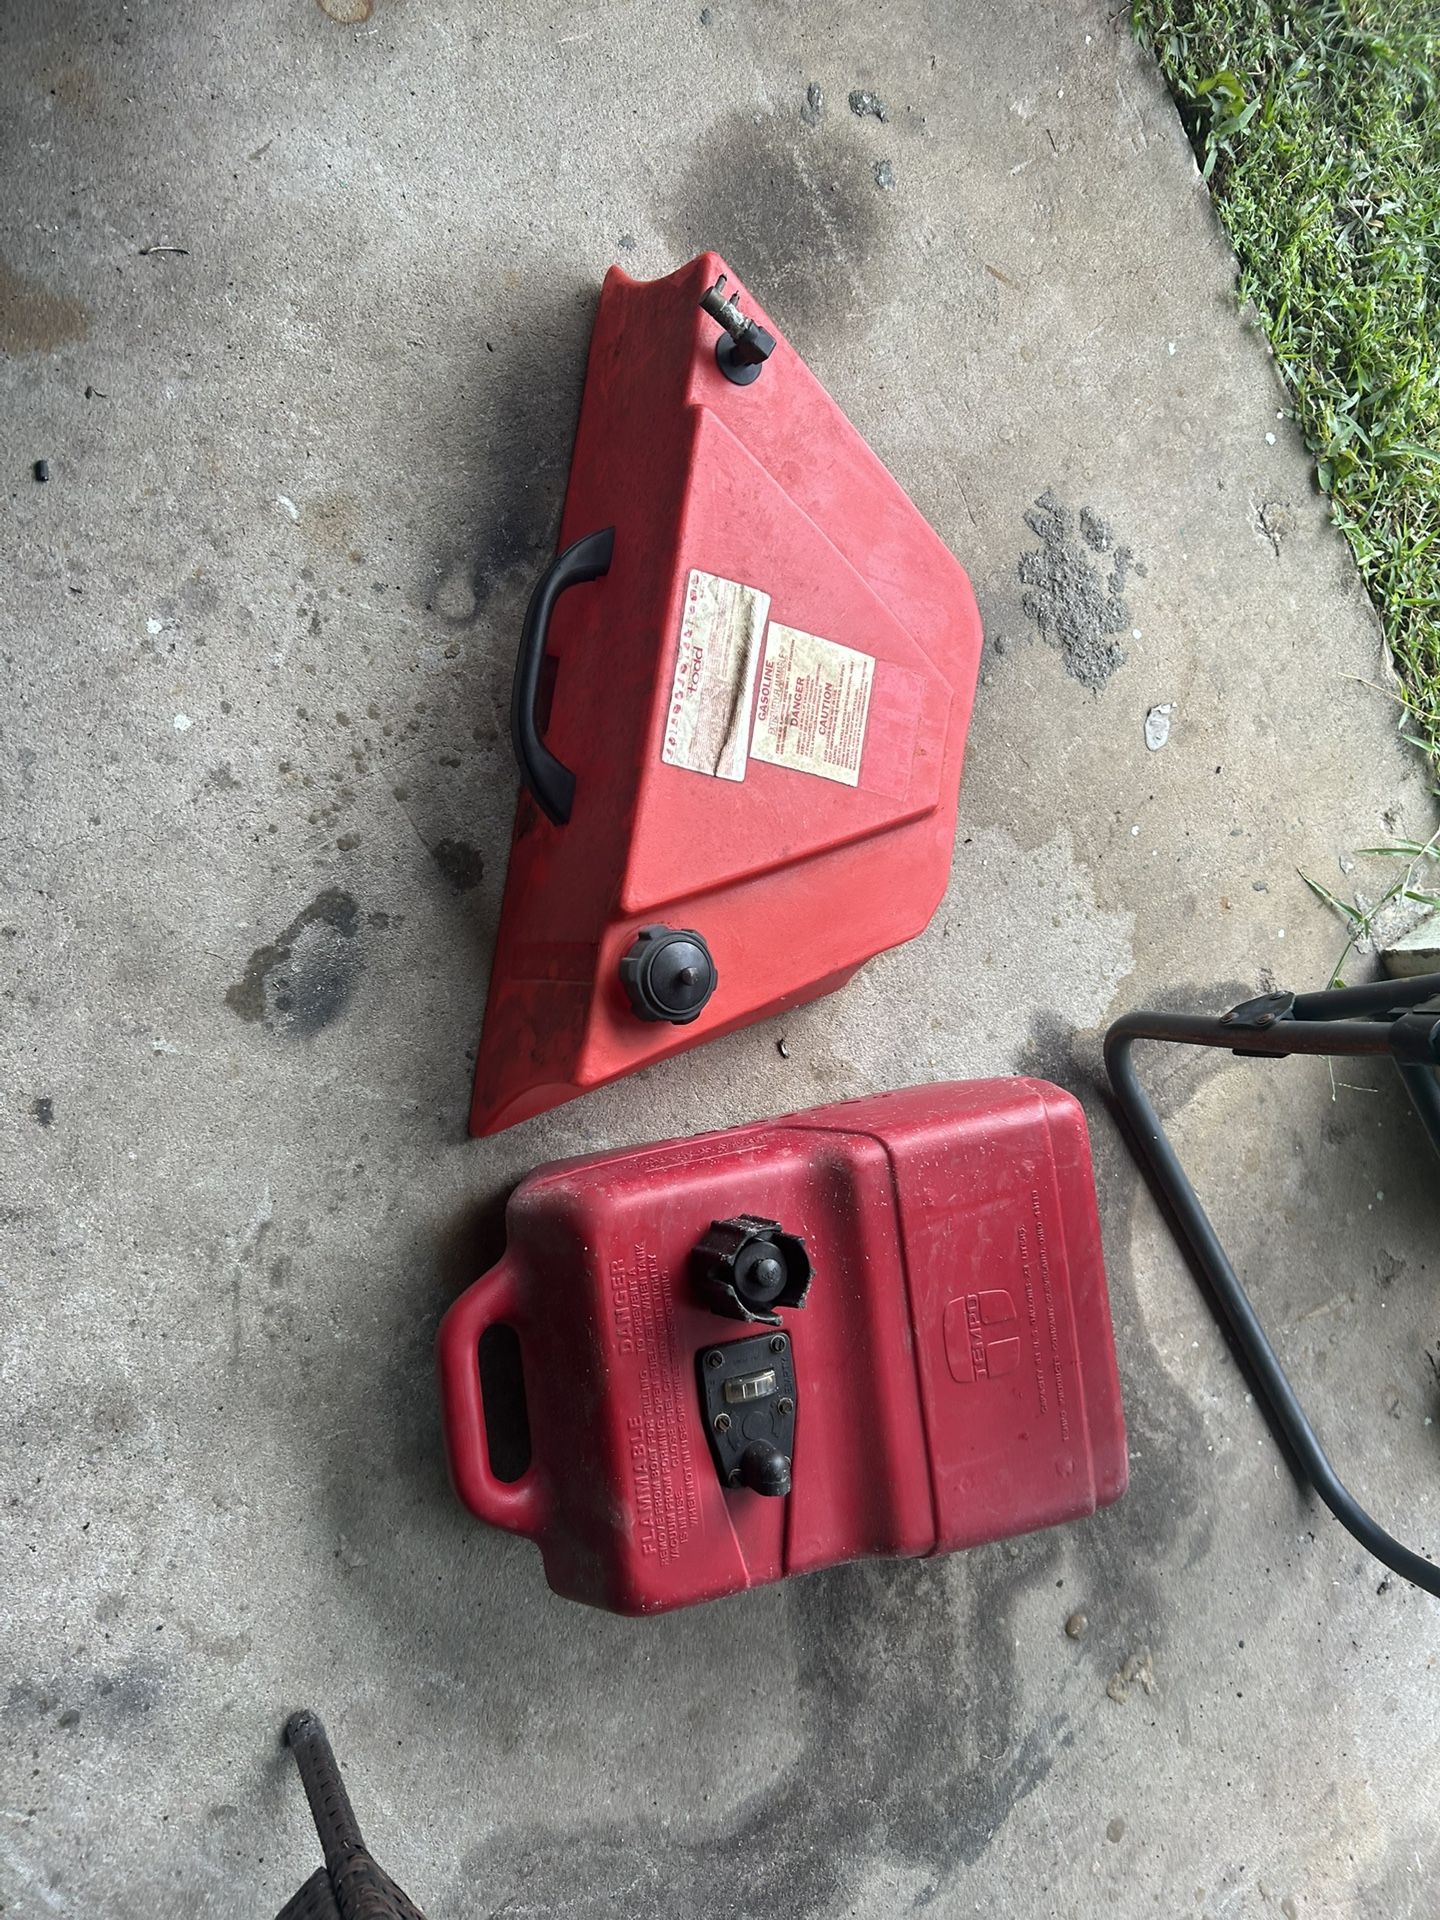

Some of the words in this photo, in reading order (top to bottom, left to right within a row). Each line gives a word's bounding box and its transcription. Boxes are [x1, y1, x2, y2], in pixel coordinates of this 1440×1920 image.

[687, 646, 703, 693] todd
[758, 660, 774, 721] GASOLINE
[790, 677, 804, 726] DANGER
[818, 682, 833, 735] CAUTION
[627, 1267, 636, 1276] A
[635, 1241, 647, 1272] TANK
[640, 1276, 652, 1311] WHEN
[648, 1253, 662, 1303] TIGHTLY
[609, 1258, 634, 1355] DANGER
[629, 1280, 642, 1334] PREVENT
[655, 1307, 667, 1337] VENT
[644, 1314, 655, 1344] VENT
[968, 1294, 986, 1376] TEMPO
[635, 1339, 646, 1354] TO
[648, 1348, 660, 1378] FUEL
[651, 1380, 663, 1413] OPEN
[664, 1394, 675, 1424] FUEL
[676, 1404, 686, 1422] OR
[645, 1419, 655, 1444] FOR
[657, 1416, 670, 1473] FORMING.
[668, 1427, 680, 1467] CLOSE
[678, 1425, 689, 1448] USE
[648, 1448, 659, 1478] BOAT
[682, 1451, 690, 1462] IN
[627, 1415, 656, 1554] FLAMMABLE
[662, 1476, 674, 1509] FROM
[684, 1466, 694, 1489] NOT
[651, 1480, 664, 1514] FROM
[674, 1487, 685, 1514] USE.
[687, 1492, 698, 1526] WHEN
[667, 1512, 680, 1559] VACUUM
[677, 1517, 686, 1529] IN
[680, 1532, 688, 1543] IS
[656, 1517, 669, 1566] REMOVE
